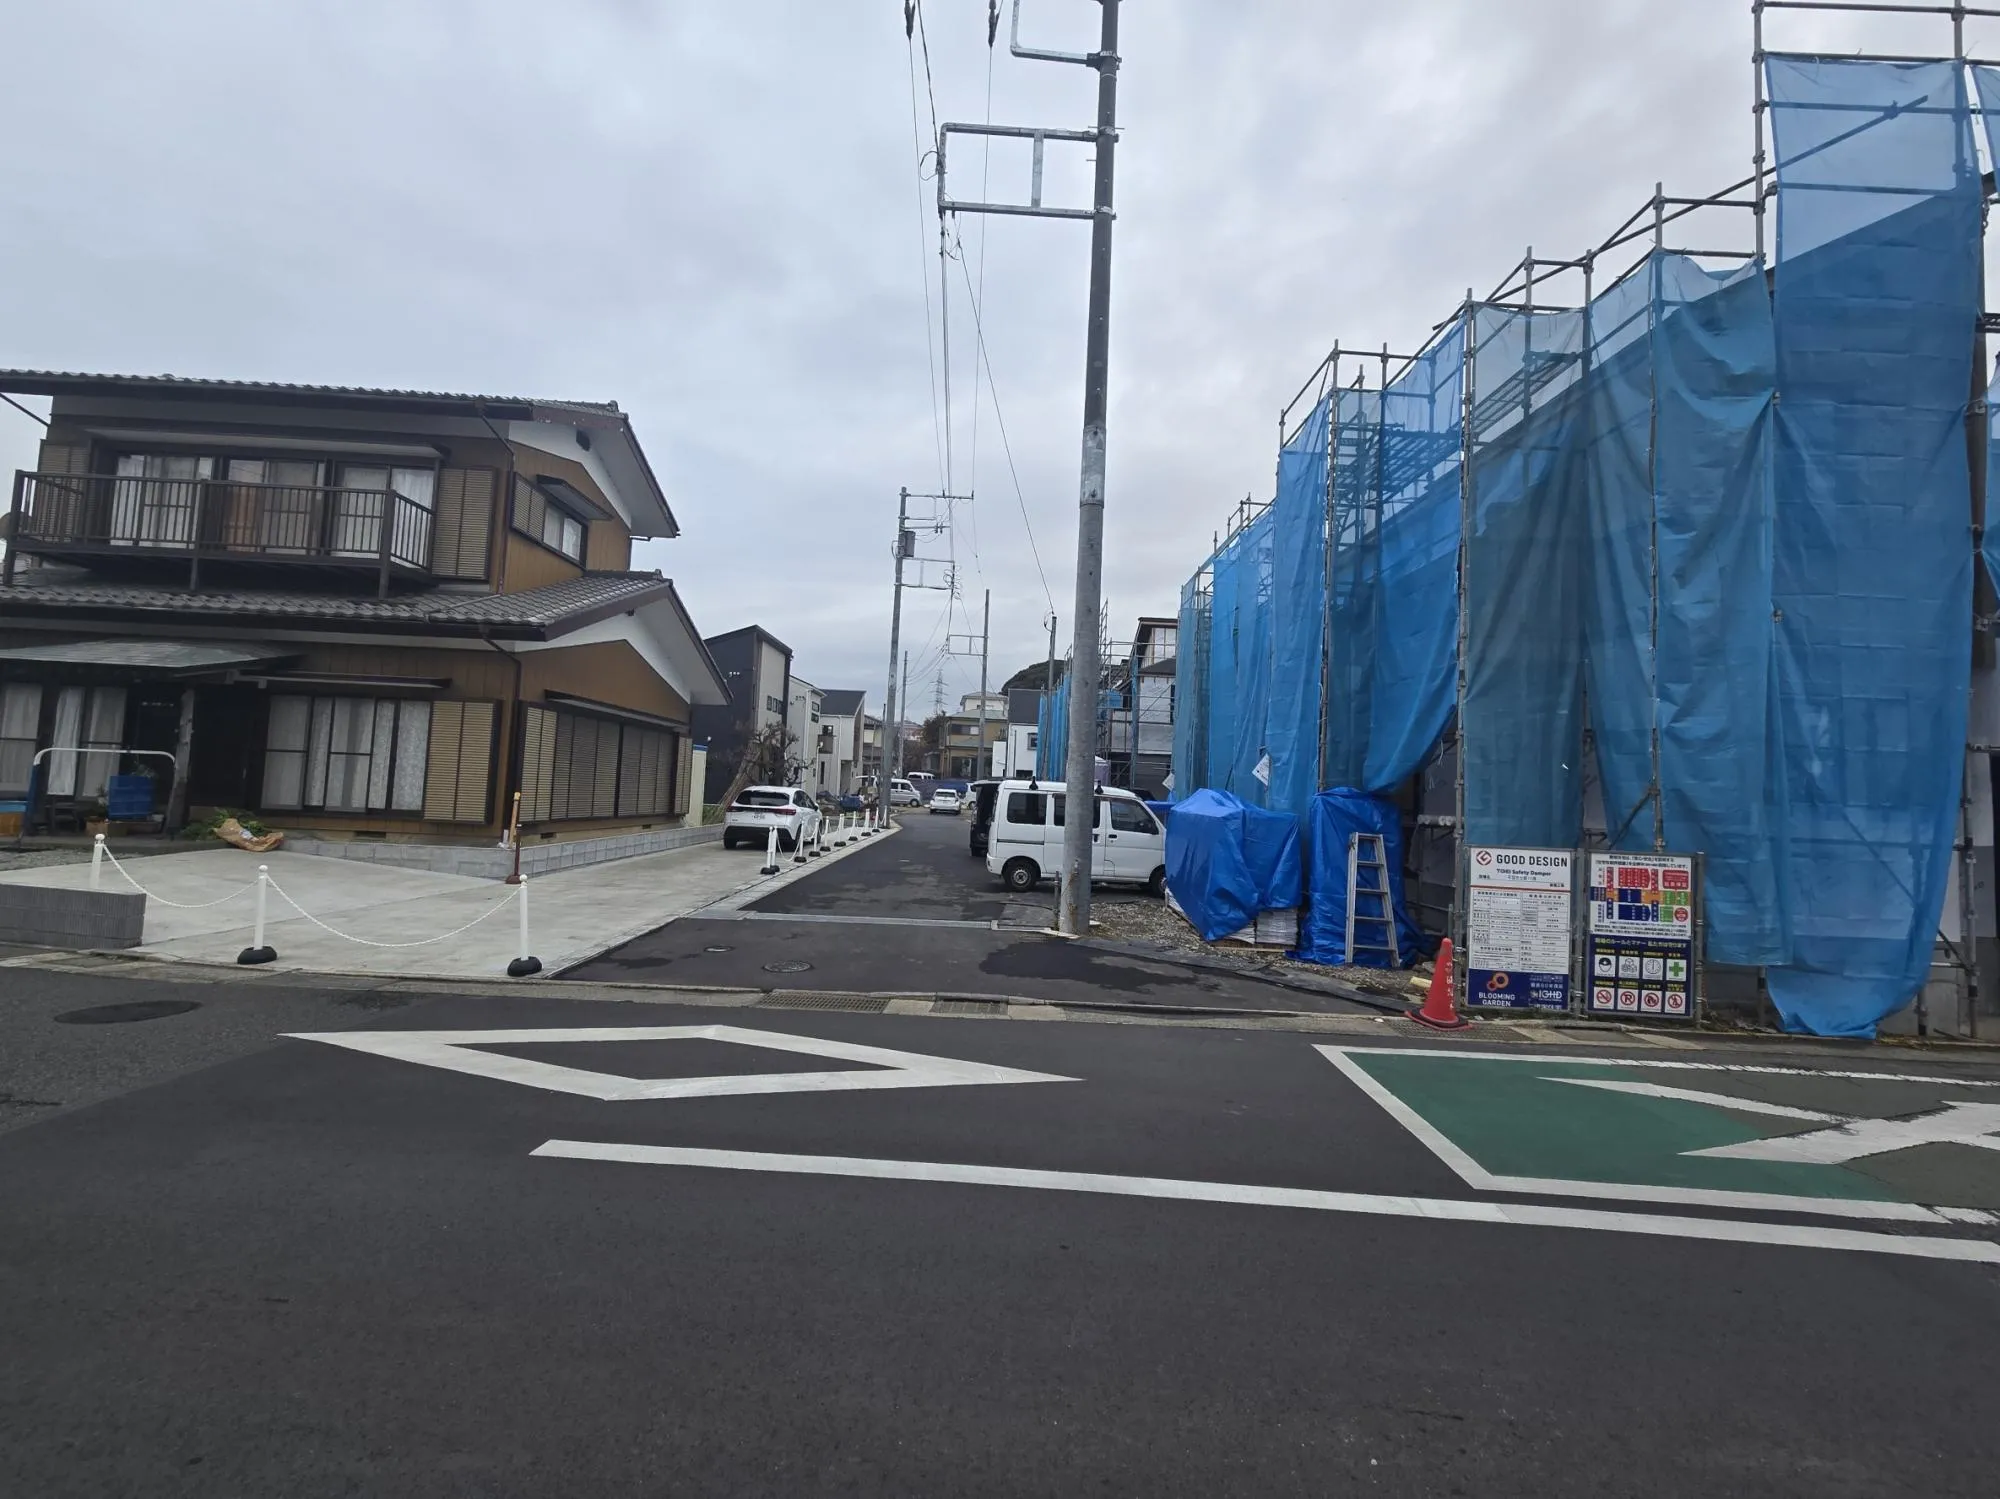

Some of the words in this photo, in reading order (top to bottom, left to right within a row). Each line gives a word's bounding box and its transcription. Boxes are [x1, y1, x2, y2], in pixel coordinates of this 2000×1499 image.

[1496, 854, 1525, 865] GOOD
[1529, 856, 1568, 867] DESIGN
[1478, 992, 1516, 1000] BLOOMING
